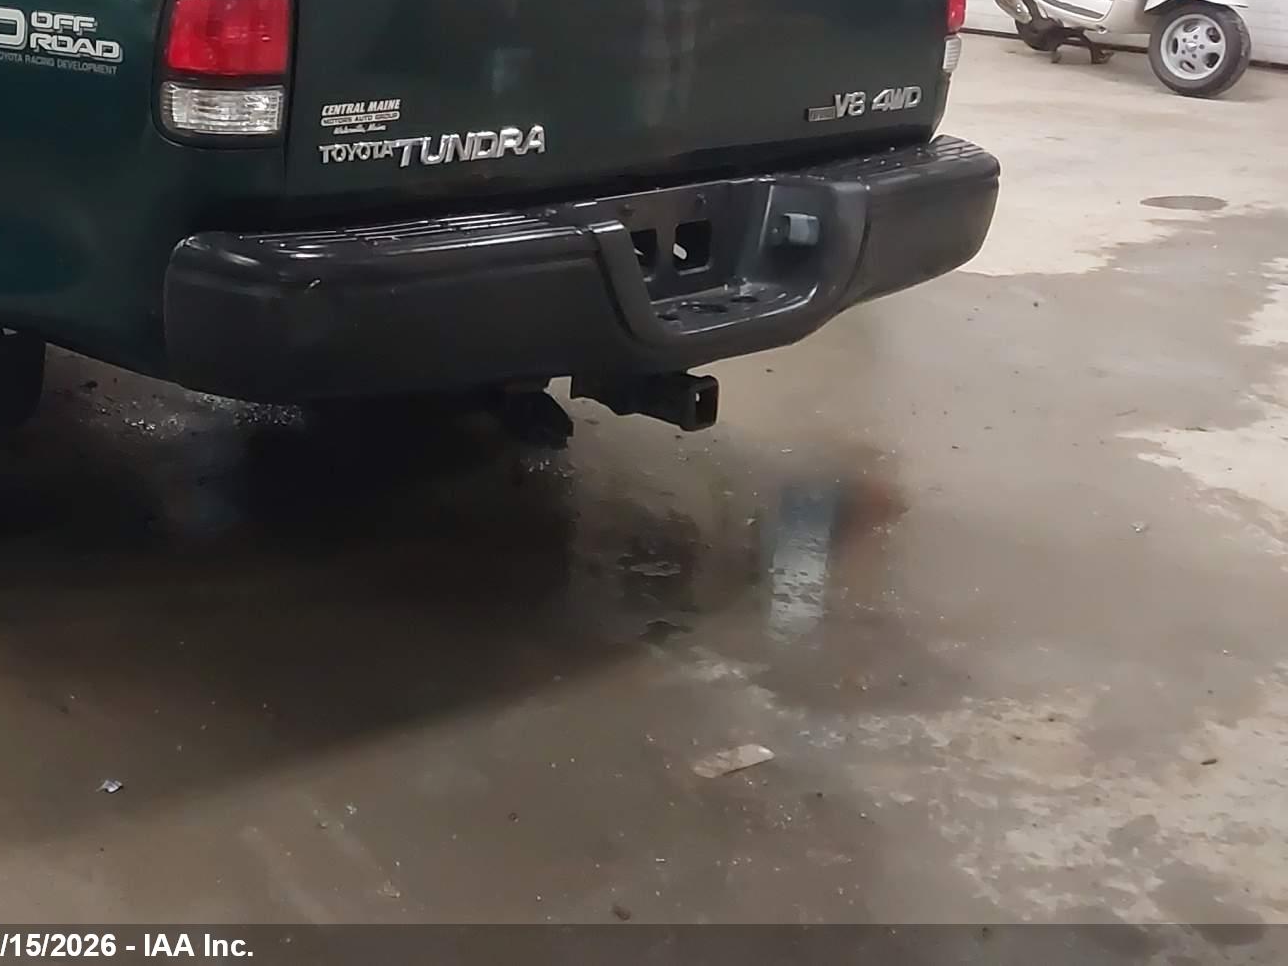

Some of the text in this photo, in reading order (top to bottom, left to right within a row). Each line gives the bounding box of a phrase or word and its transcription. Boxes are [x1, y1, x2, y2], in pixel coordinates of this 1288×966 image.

[31, 11, 97, 34] OFF
[29, 33, 123, 63] ROAD
[24, 54, 55, 67] RACING
[57, 58, 118, 75] DEVELOPMENT
[321, 98, 401, 116] CENTRAL MAINE
[835, 91, 866, 118] V8
[872, 86, 922, 111] 4WD
[318, 125, 546, 167] TOYOTA TUNDRA
